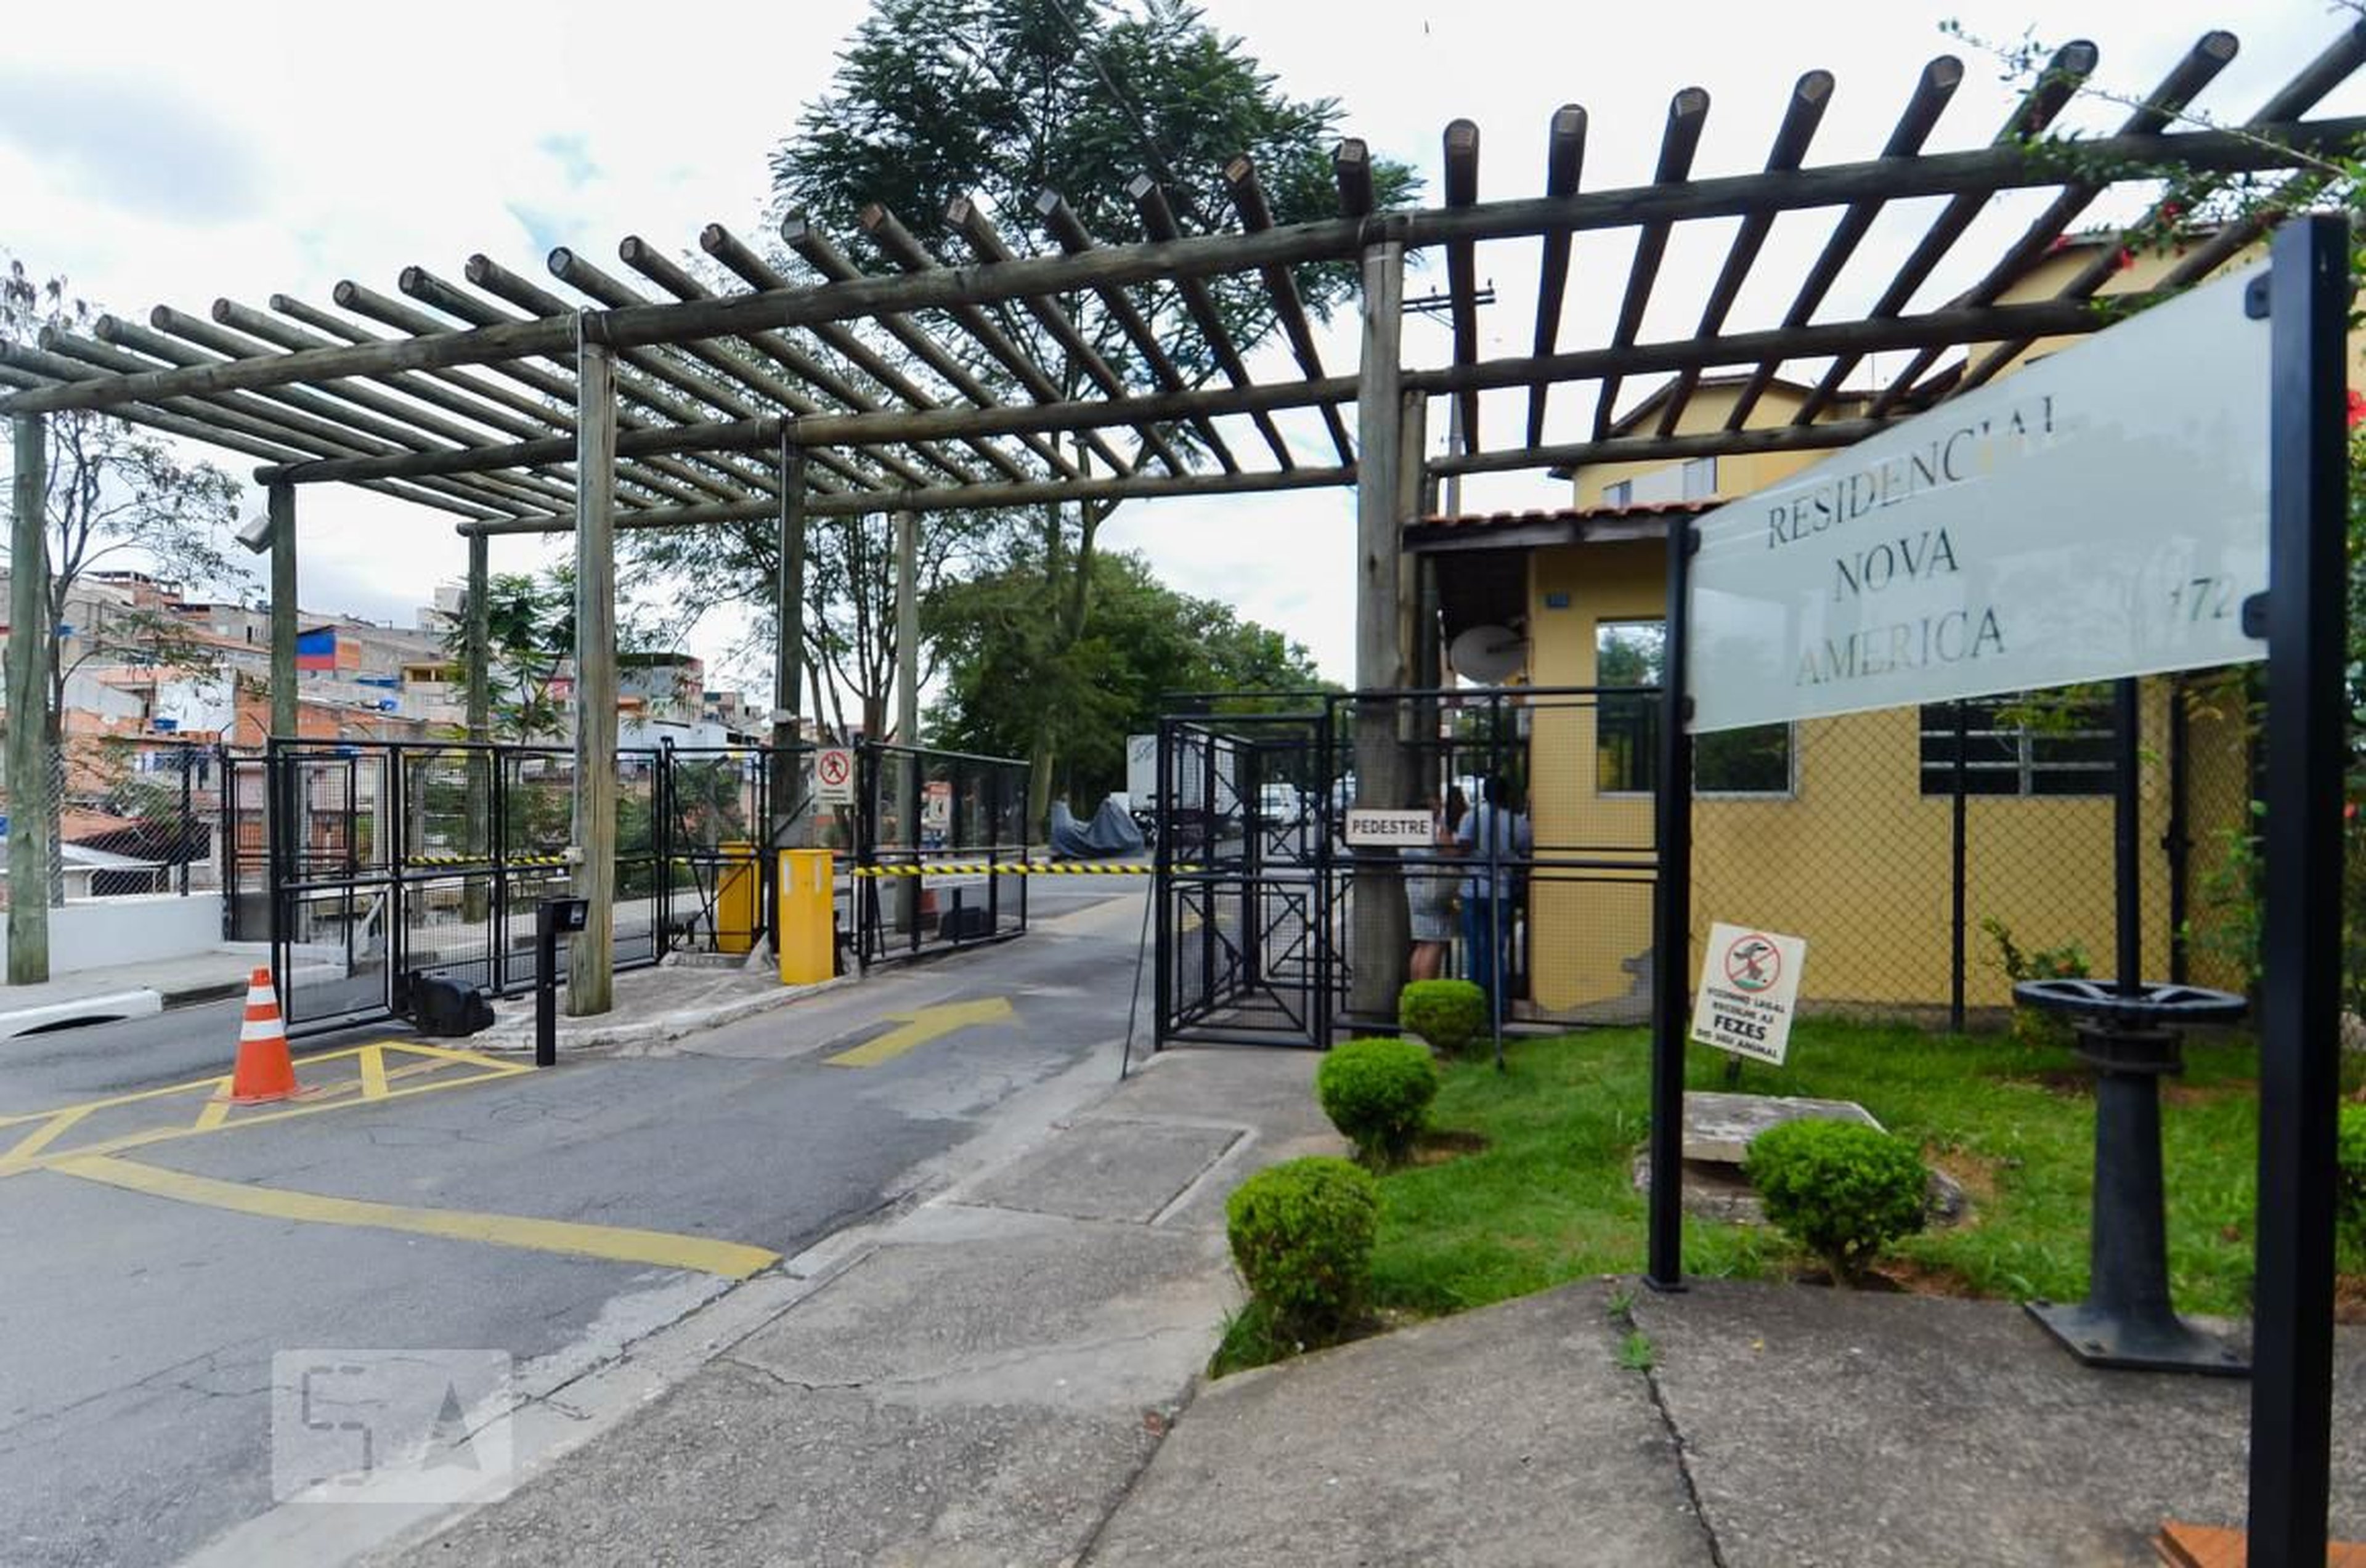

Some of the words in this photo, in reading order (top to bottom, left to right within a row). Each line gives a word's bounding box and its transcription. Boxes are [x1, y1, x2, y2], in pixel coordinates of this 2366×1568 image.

[1832, 526, 1960, 602] NOVA
[1794, 606, 2007, 687] AMERICA
[1352, 819, 1429, 834] PEDESTRE
[1714, 1014, 1766, 1041] FEZES
